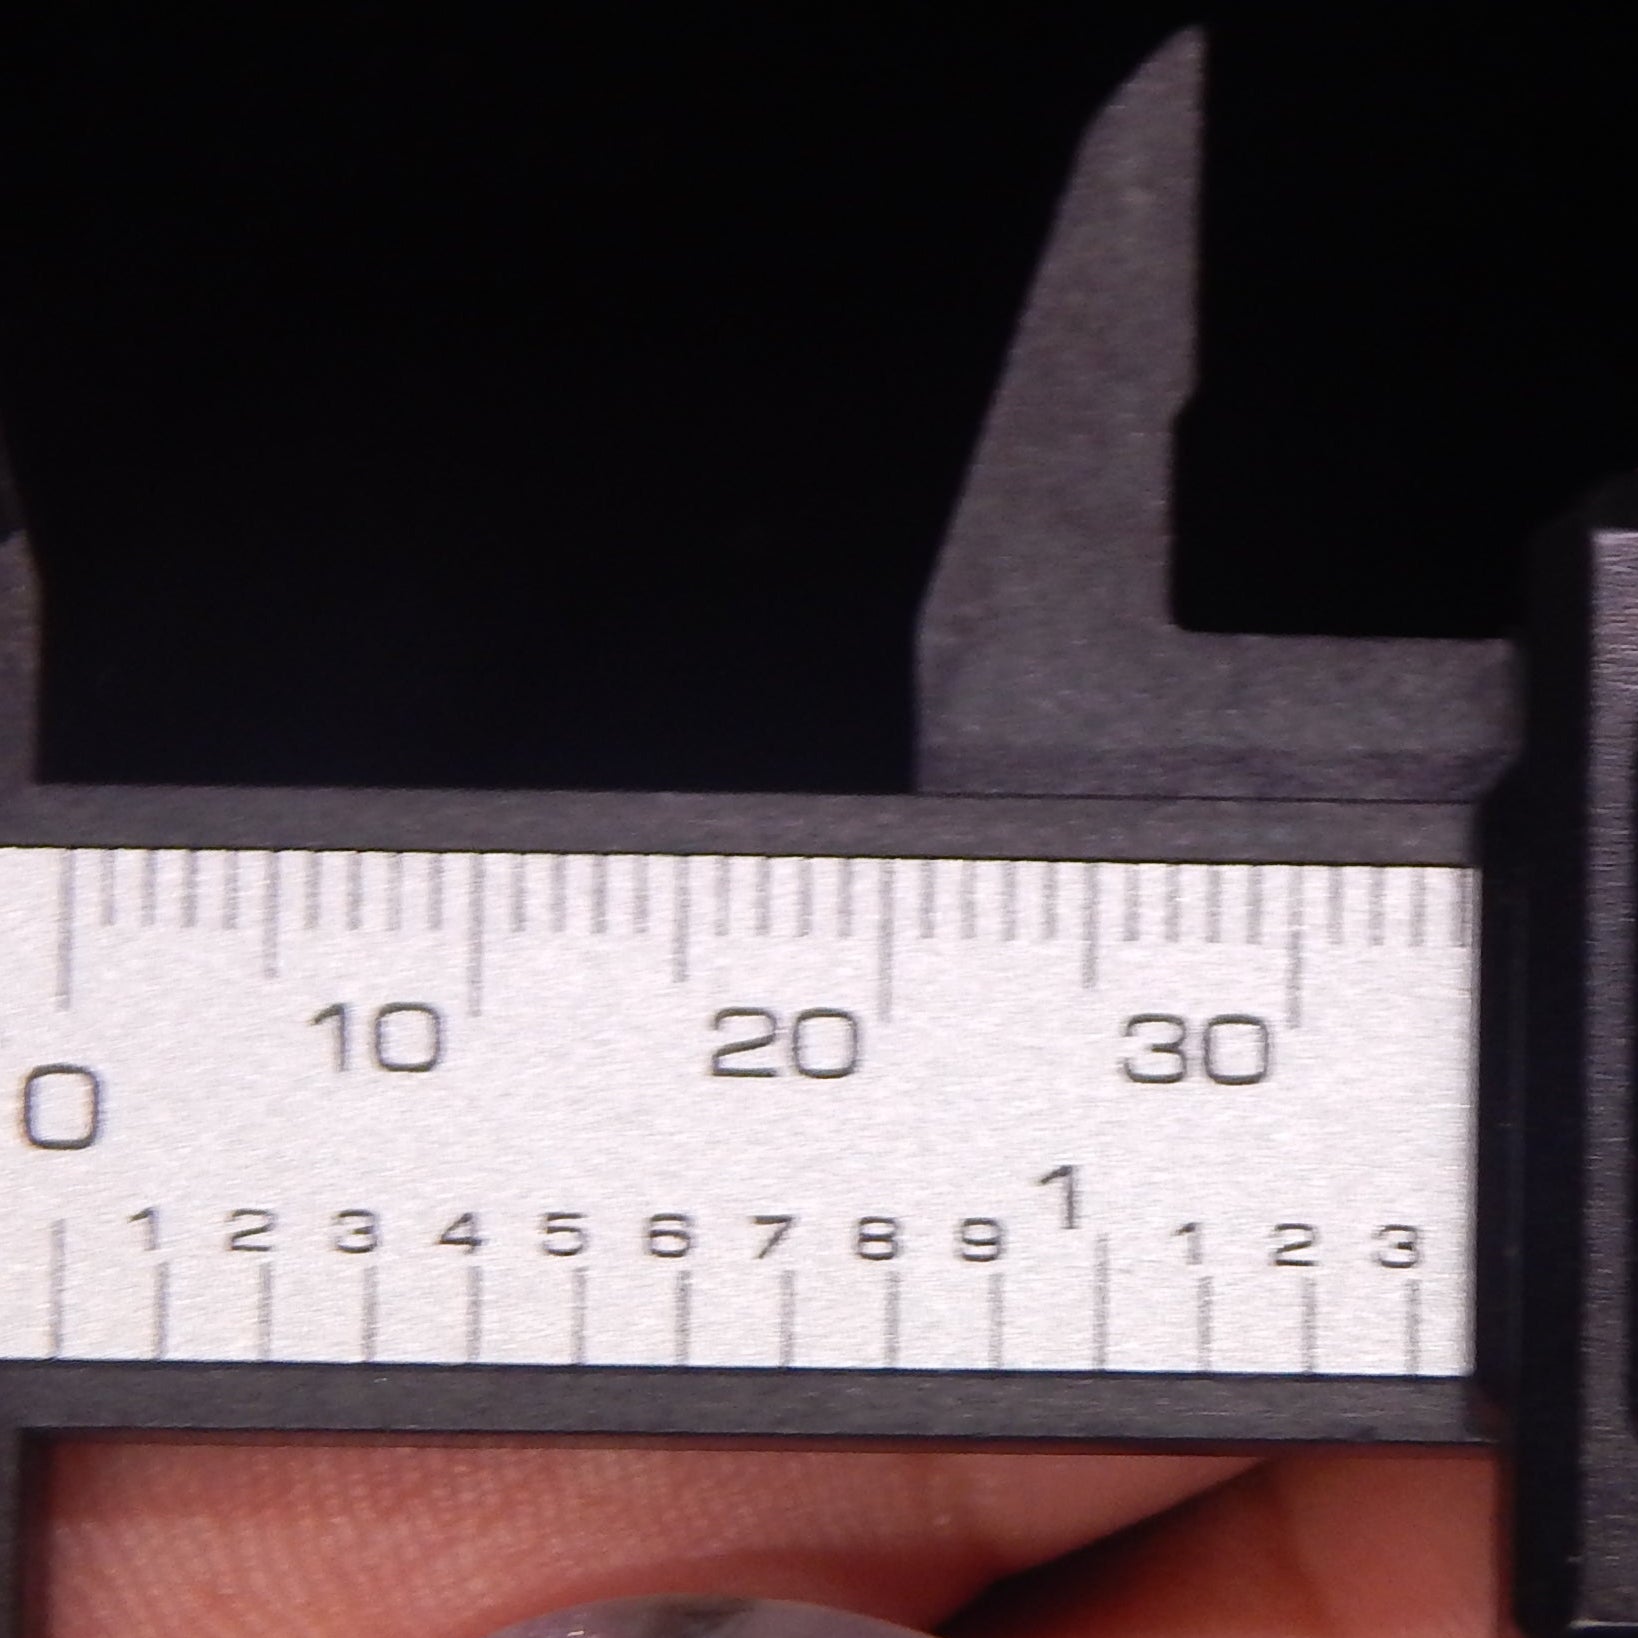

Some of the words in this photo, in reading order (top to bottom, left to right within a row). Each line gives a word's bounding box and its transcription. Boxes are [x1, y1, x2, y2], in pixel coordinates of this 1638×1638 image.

[308, 1001, 443, 1074] 10
[709, 1006, 861, 1080] 20
[1122, 1012, 1272, 1087] 30
[18, 1062, 104, 1152] 0
[1035, 1163, 1079, 1231] 1
[128, 1206, 160, 1252] 1
[226, 1208, 275, 1254] 2
[333, 1209, 381, 1256] 3
[436, 1211, 484, 1255] 4
[540, 1213, 586, 1258] 5
[645, 1213, 694, 1260] 6
[751, 1214, 796, 1261] 7
[854, 1215, 902, 1263] 8
[957, 1217, 1005, 1265] 9
[1176, 1220, 1203, 1266] 1
[1270, 1222, 1318, 1269] 2
[1375, 1223, 1422, 1271] 3
